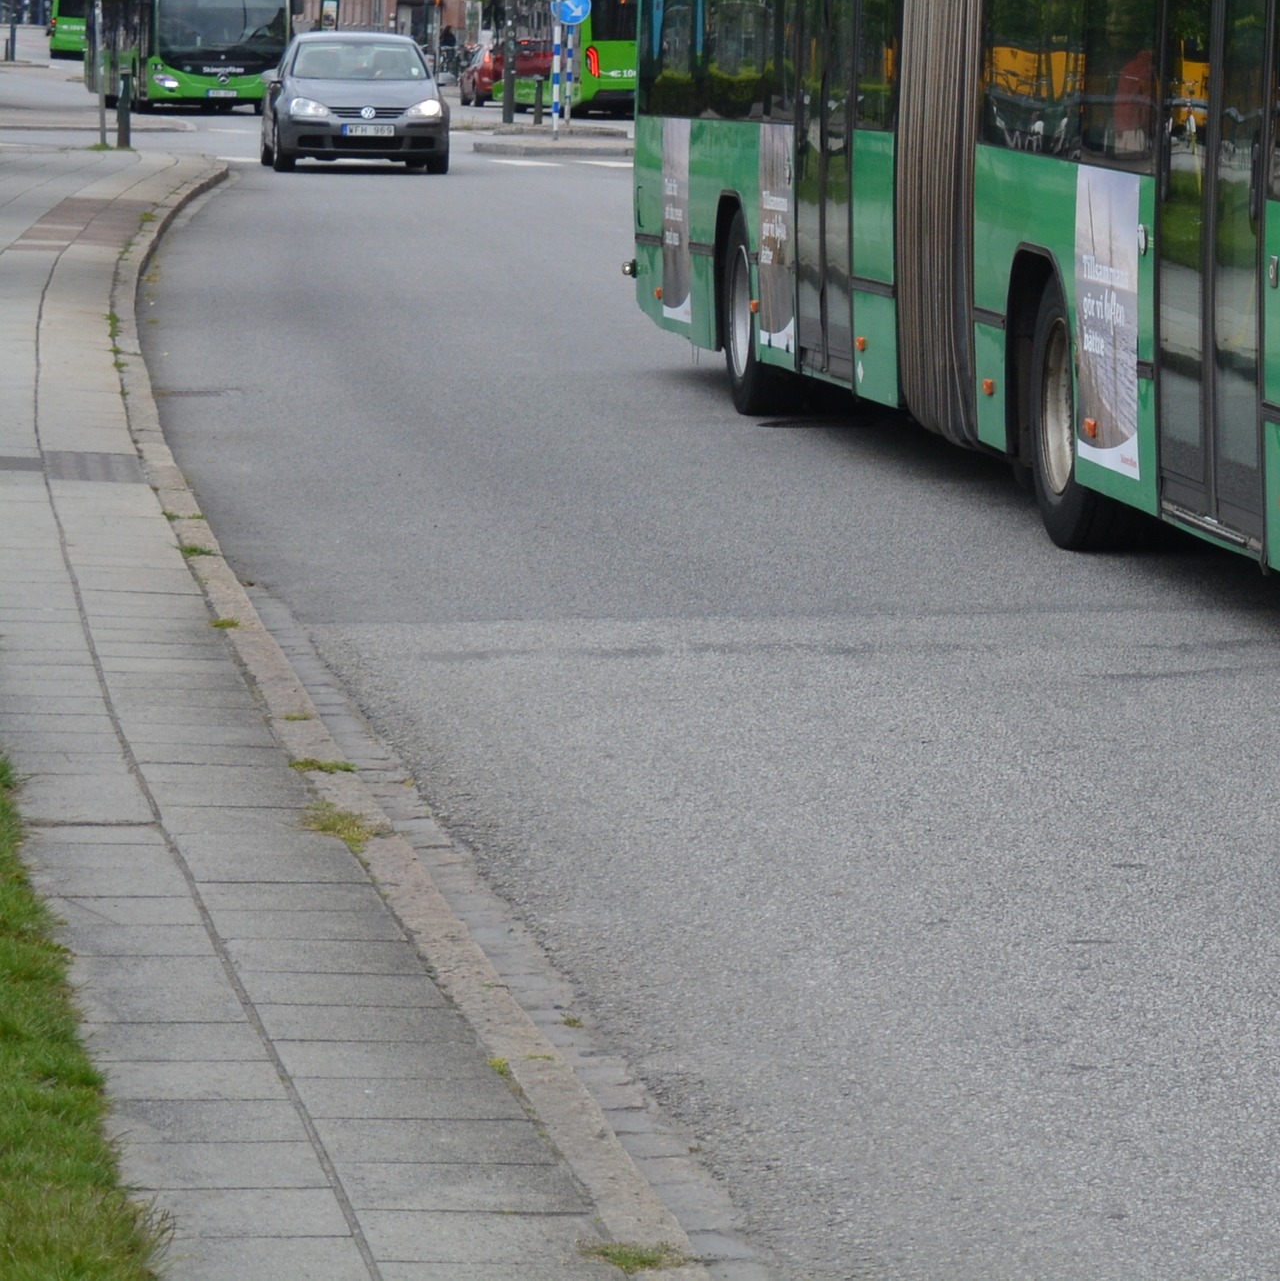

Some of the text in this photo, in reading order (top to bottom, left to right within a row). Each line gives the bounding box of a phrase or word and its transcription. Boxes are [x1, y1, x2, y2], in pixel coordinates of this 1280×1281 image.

[348, 125, 393, 135] WFH 969
[1082, 254, 1129, 290] Tillsammans
[1083, 293, 1095, 321] gör
[1096, 295, 1103, 320] vi
[1083, 325, 1104, 356] bättre
